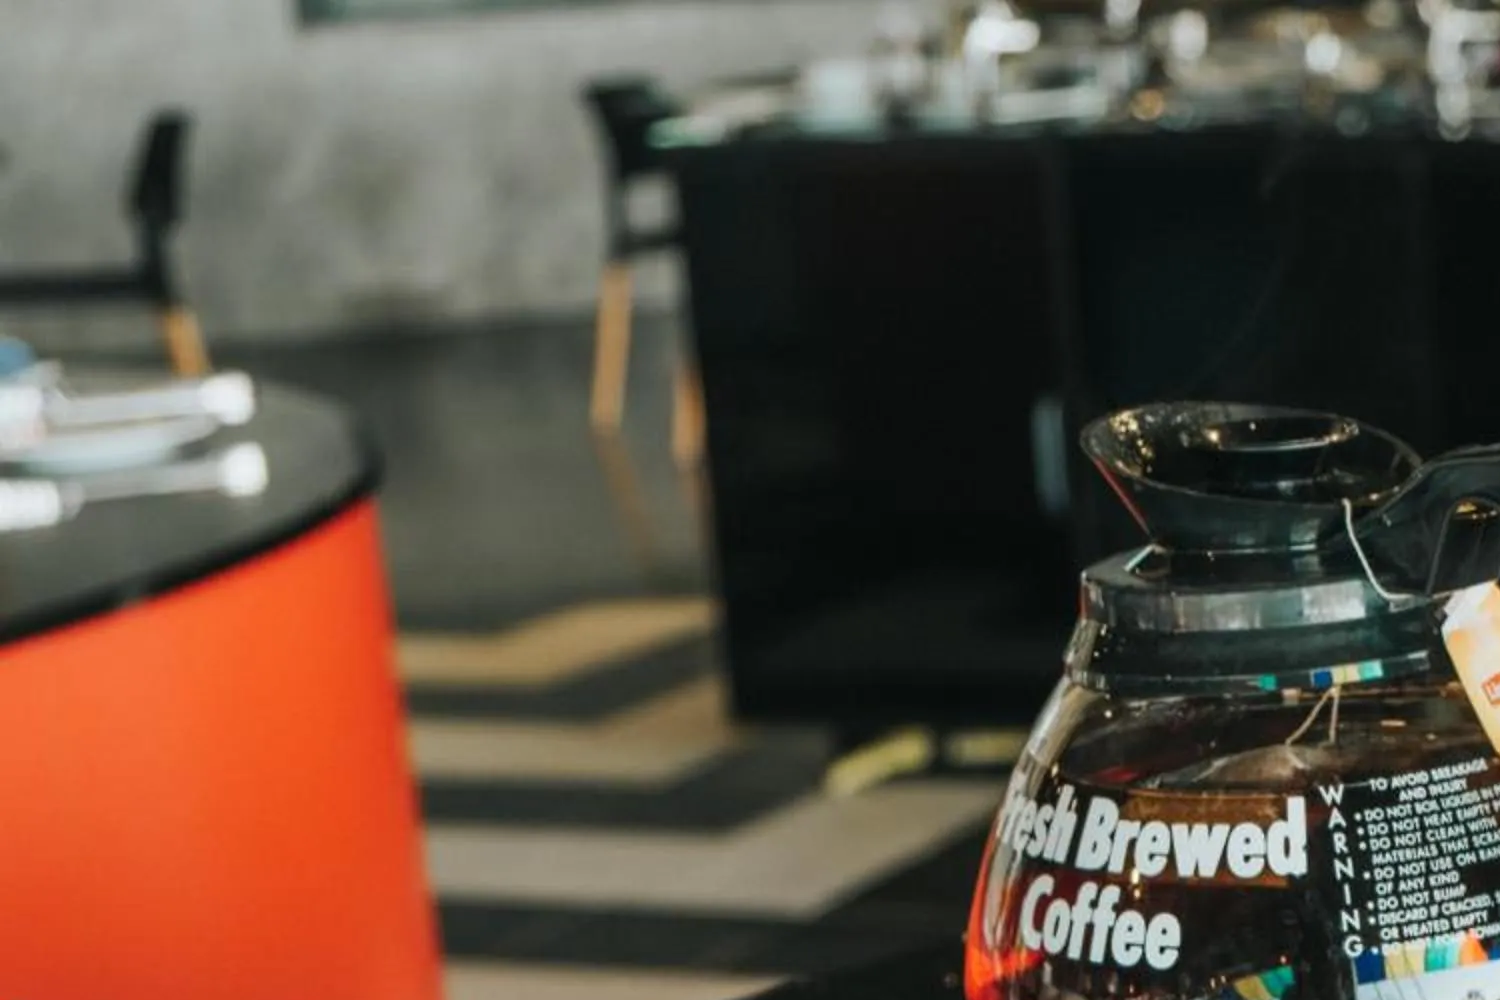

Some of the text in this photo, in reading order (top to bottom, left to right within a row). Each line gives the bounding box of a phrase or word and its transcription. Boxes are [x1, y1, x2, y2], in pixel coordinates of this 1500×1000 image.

[1369, 777, 1388, 792] TO
[1391, 769, 1429, 789] AVOID
[1399, 786, 1427, 802] AND
[1363, 807, 1385, 822] DO
[1386, 802, 1412, 818] NOT
[1366, 821, 1389, 837] DO
[1391, 816, 1420, 833] NOT
[1423, 810, 1453, 828] HEAT
[1074, 795, 1309, 879] Brewed
[1369, 836, 1391, 851] DO
[1393, 831, 1422, 847] NOT
[1425, 824, 1465, 842] CLEAN
[1372, 843, 1439, 866] MATERIALS
[1441, 837, 1470, 854] THAT
[1373, 865, 1395, 881] DO
[1398, 860, 1426, 876] NOT
[1428, 855, 1454, 872] USE
[1455, 850, 1477, 867] ON
[1375, 869, 1460, 896] OF ANY KIND
[1377, 883, 1467, 911] DO NOT BUMP
[1020, 873, 1182, 970] Coffee
[1380, 925, 1400, 940] OR
[1402, 917, 1451, 938] HEATED
